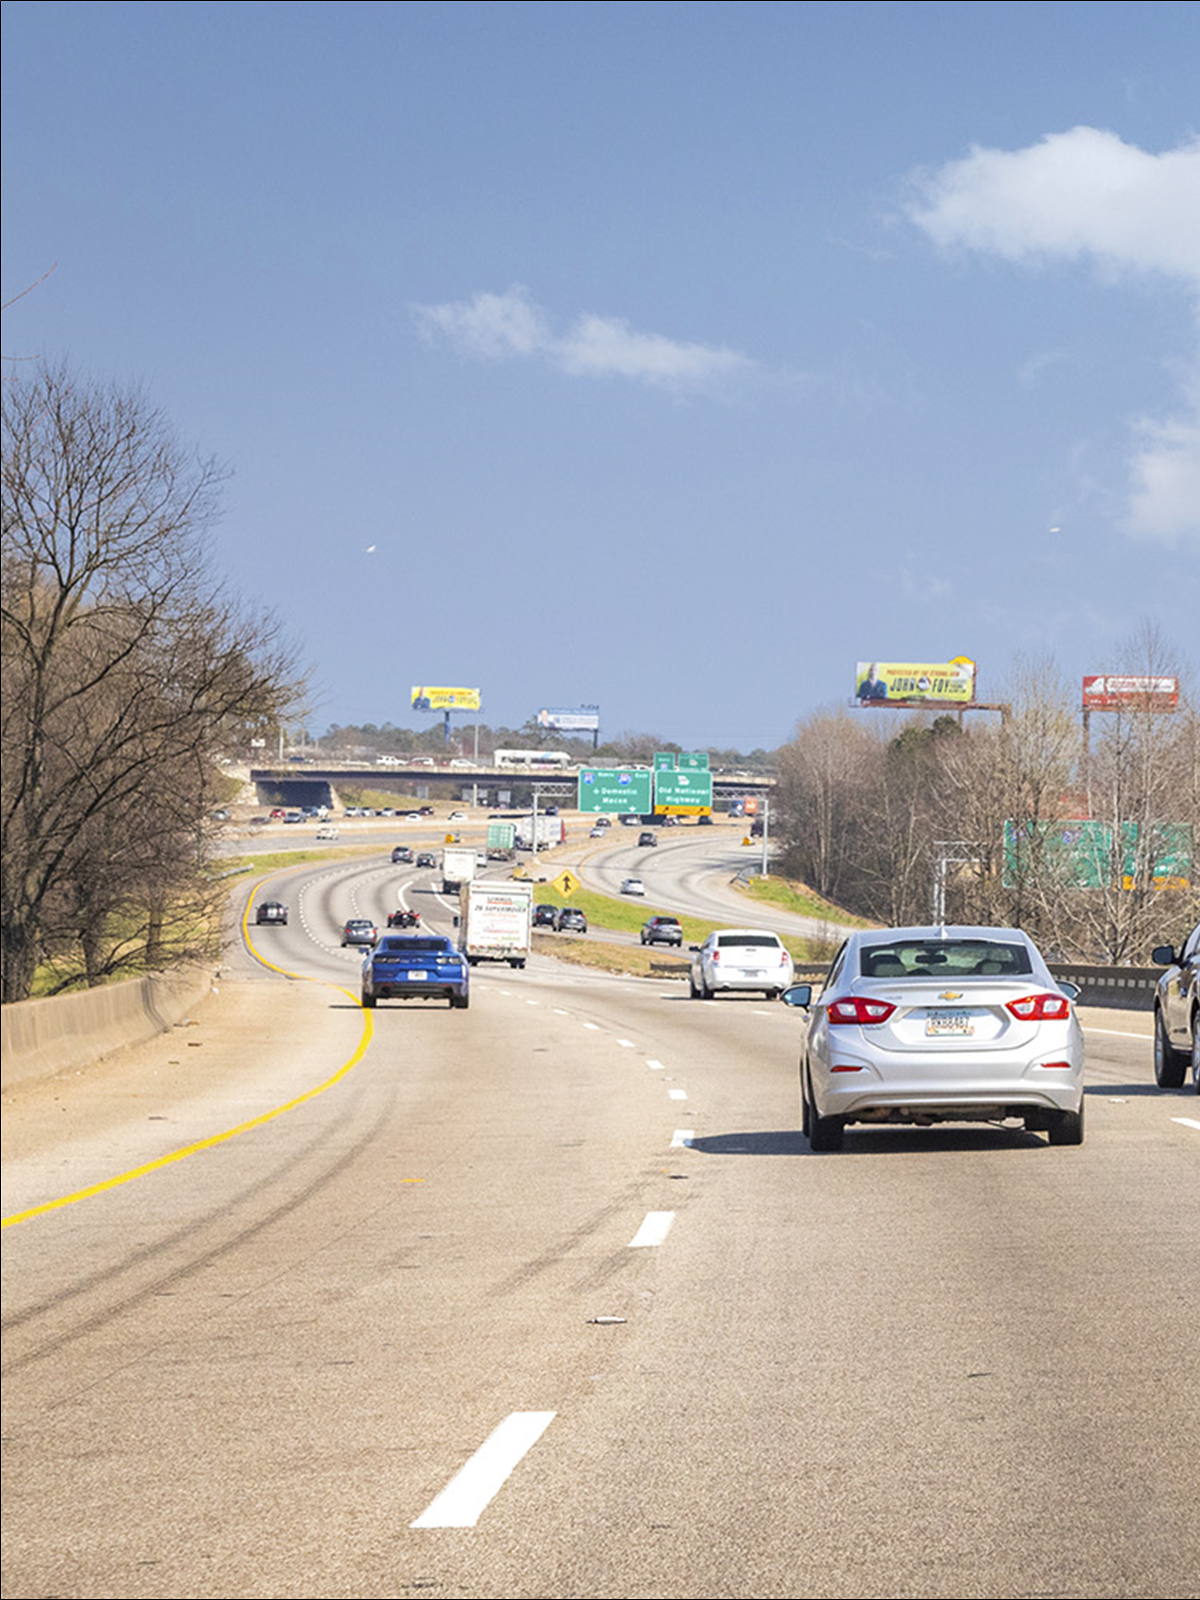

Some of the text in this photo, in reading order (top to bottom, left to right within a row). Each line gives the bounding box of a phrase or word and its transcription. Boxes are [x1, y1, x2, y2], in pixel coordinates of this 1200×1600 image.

[890, 677, 916, 691] JOHN
[932, 678, 950, 692] FOY
[601, 787, 638, 795] Domestic
[666, 796, 701, 804] Highway
